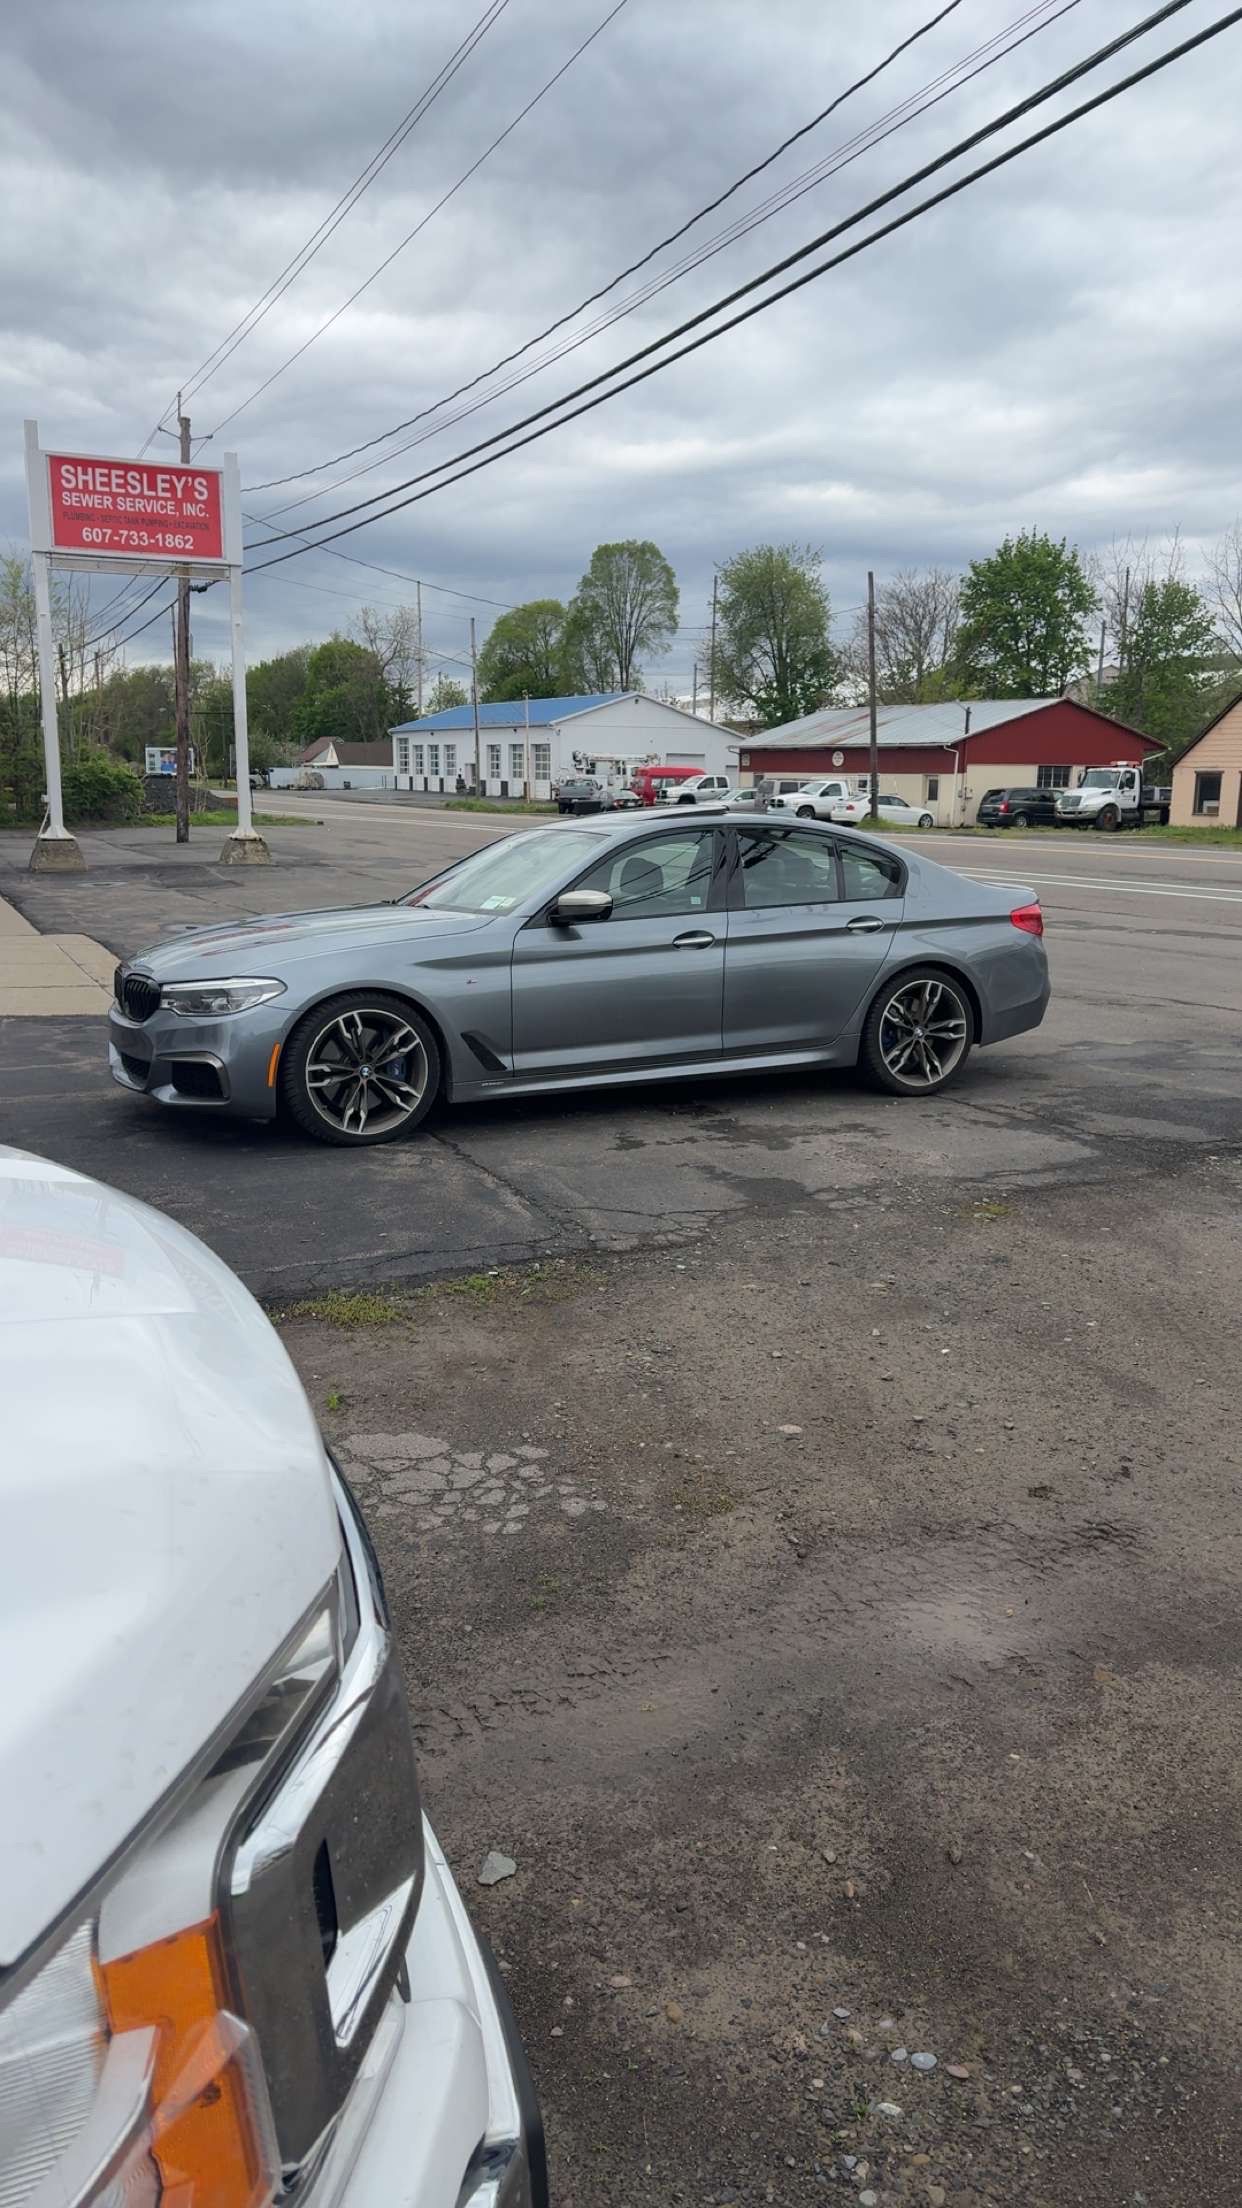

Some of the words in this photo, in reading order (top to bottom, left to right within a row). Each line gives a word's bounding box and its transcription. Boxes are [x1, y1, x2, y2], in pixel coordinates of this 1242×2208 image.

[61, 464, 208, 500] SHEESLEY'S
[62, 491, 114, 510] SEWER
[117, 496, 179, 518] SERVICE,
[183, 502, 209, 517] INC.
[82, 527, 194, 550] 607-733-1862
